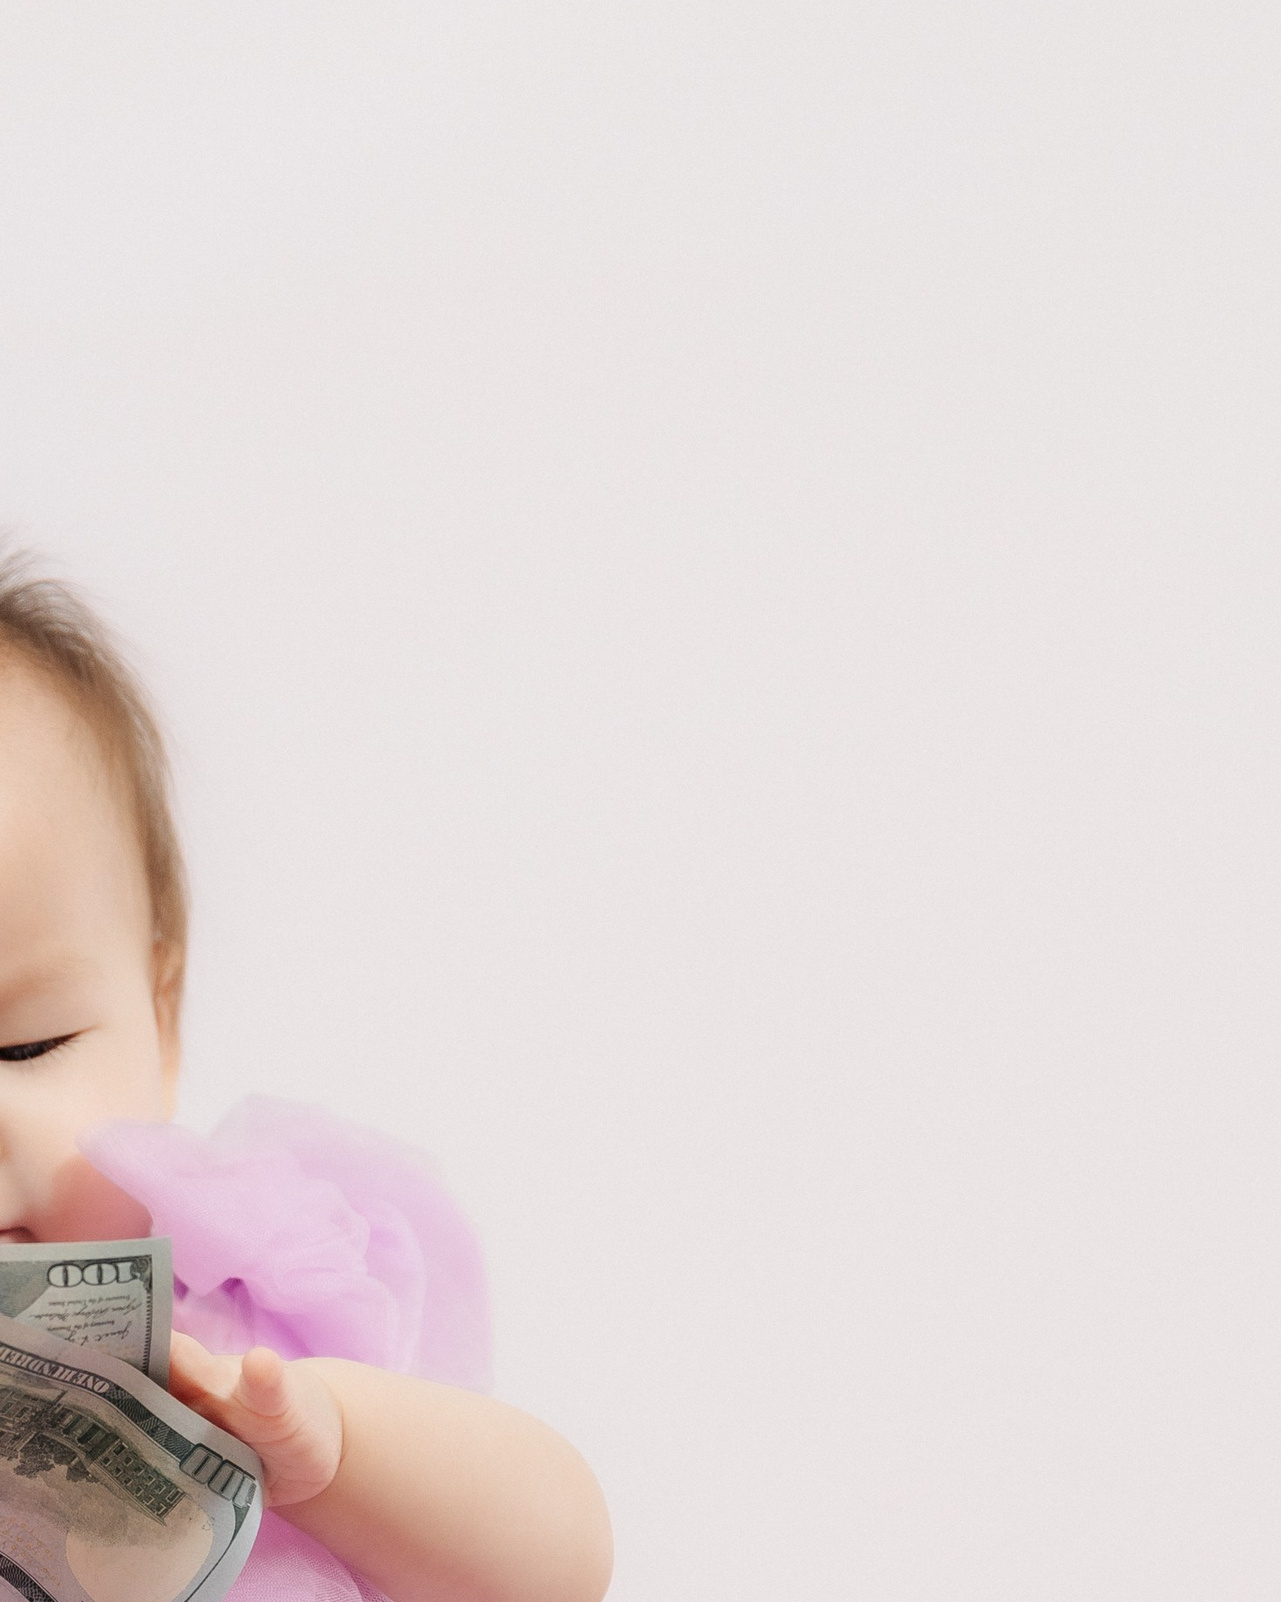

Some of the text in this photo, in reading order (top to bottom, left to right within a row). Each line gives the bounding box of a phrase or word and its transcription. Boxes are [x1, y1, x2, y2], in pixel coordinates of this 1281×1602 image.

[47, 1262, 139, 1288] 100
[73, 1372, 110, 1394] ONE
[179, 1443, 256, 1508] 100
